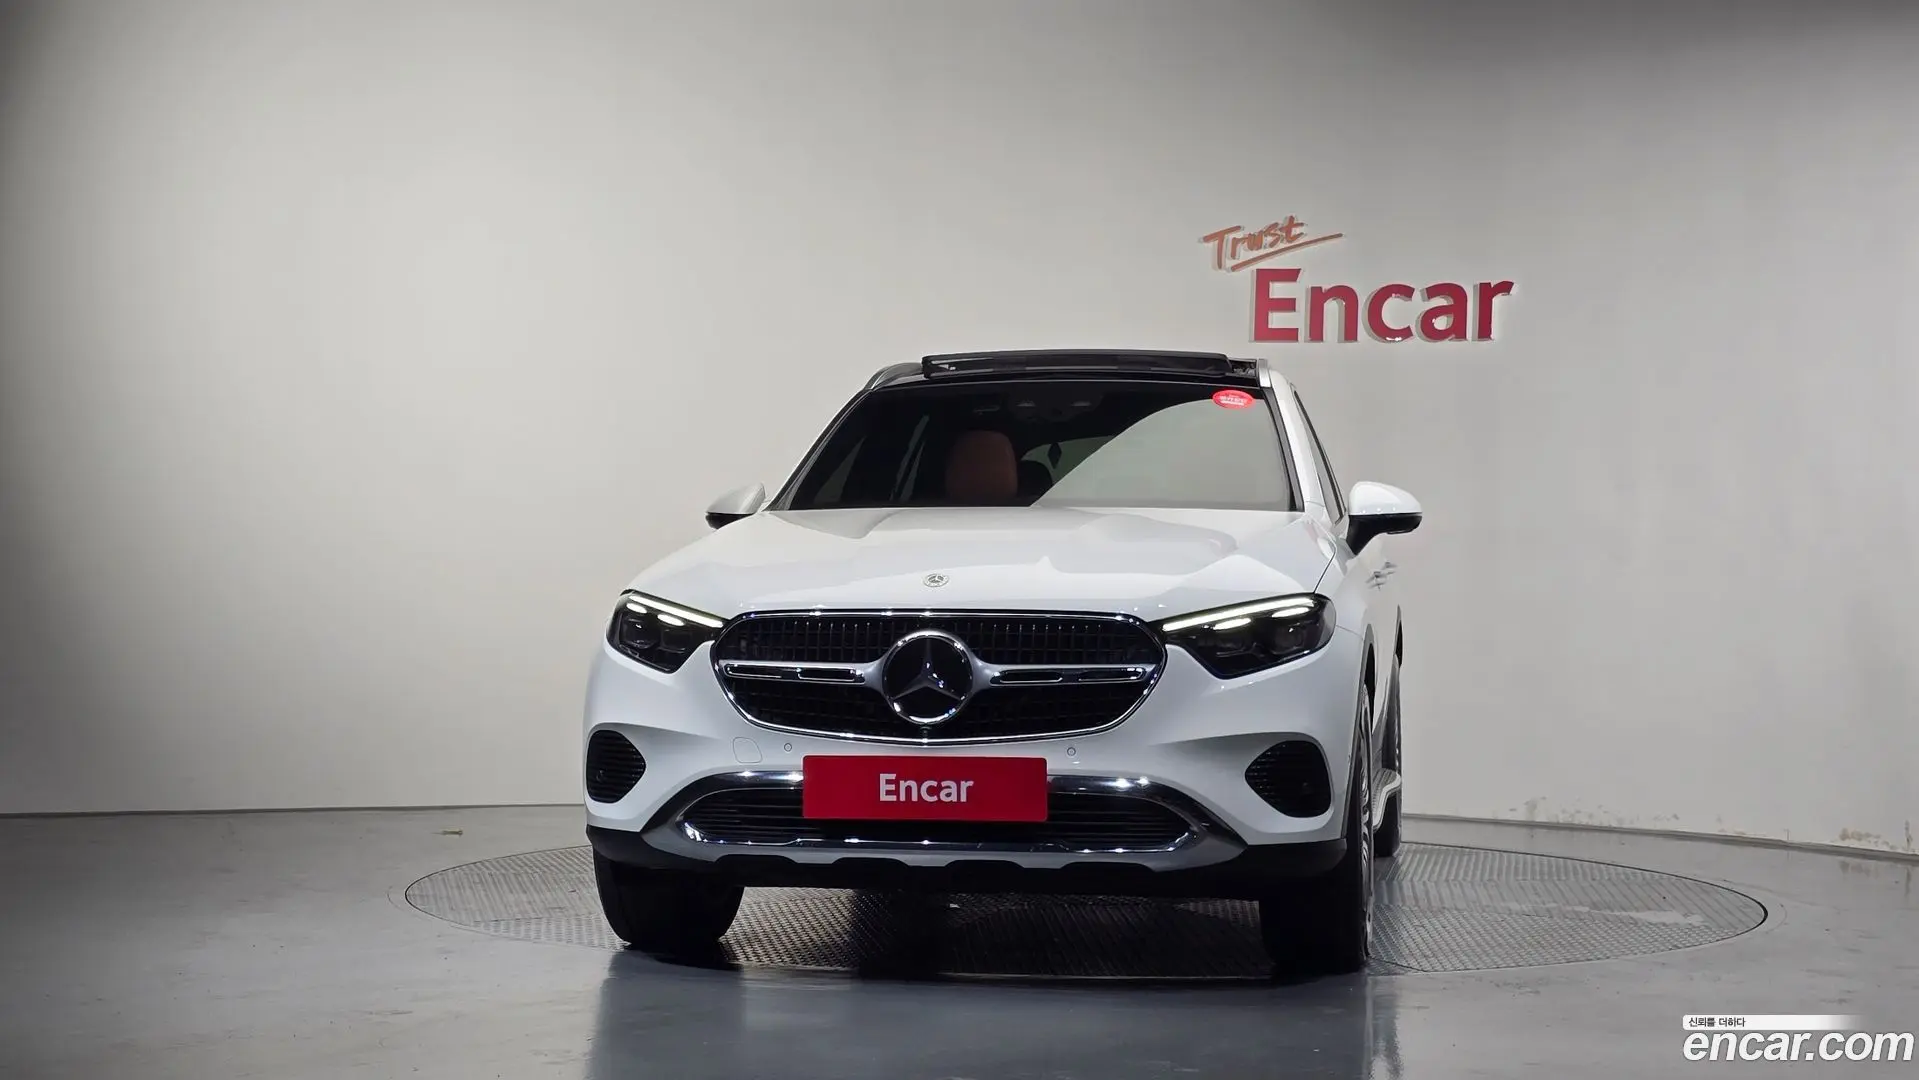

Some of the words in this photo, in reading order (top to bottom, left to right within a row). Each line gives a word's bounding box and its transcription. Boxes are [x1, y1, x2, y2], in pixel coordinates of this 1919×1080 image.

[1202, 215, 1305, 270] Trust
[1252, 268, 1515, 342] Encar
[879, 773, 974, 802] Encar
